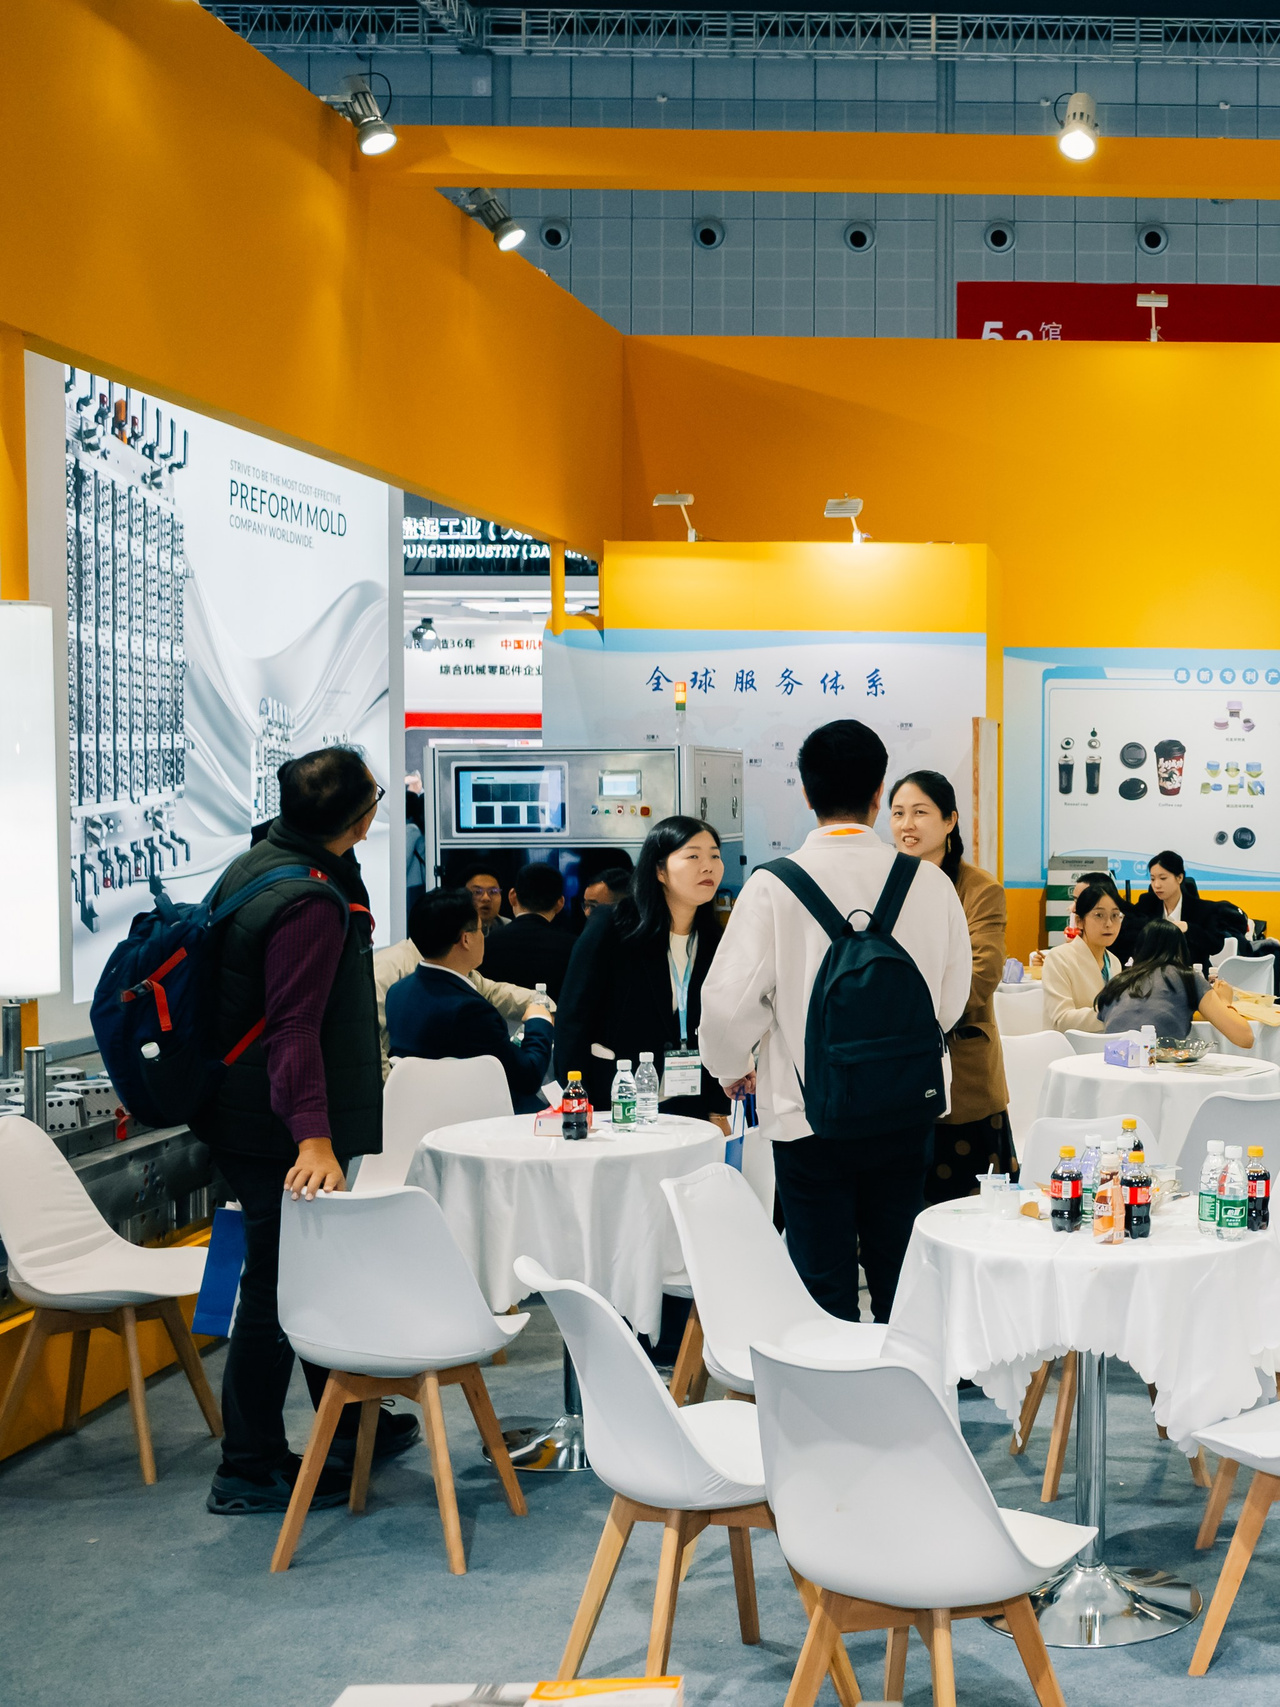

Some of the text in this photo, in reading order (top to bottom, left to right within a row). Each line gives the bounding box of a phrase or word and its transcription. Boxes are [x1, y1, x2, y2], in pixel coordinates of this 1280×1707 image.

[230, 459, 341, 506] STRIVE TO BE THE MOST COST-EFFECTIVE
[229, 478, 347, 537] PREFORM MOLD
[229, 513, 268, 536] COMPANY
[448, 544, 520, 559] INDUSTRY
[645, 665, 886, 697] 全球服务体系
